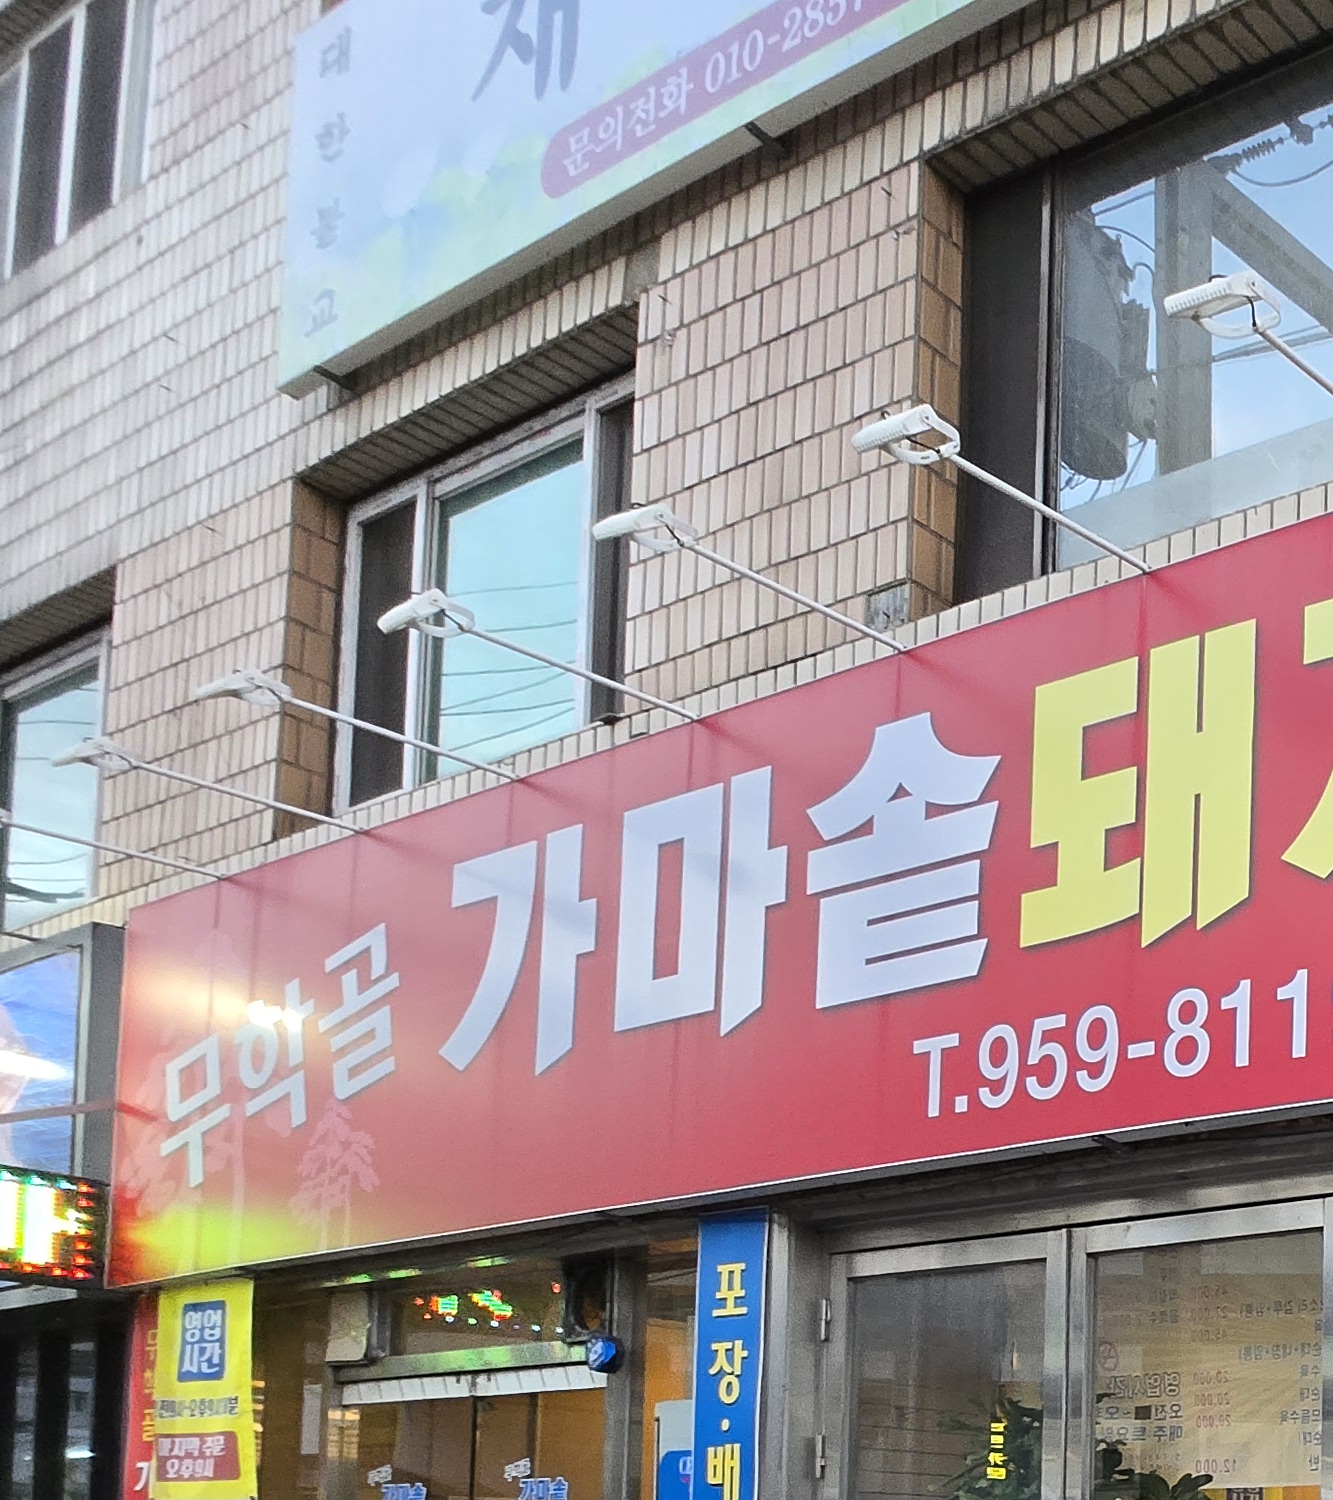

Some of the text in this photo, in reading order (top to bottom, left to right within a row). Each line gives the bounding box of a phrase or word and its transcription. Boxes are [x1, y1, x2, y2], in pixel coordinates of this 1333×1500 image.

[561, 67, 694, 177] 문의전화
[303, 26, 353, 338] 대한불교
[160, 922, 399, 1186] 무학골
[181, 1343, 222, 1374] 시간
[184, 1309, 223, 1342] 영업
